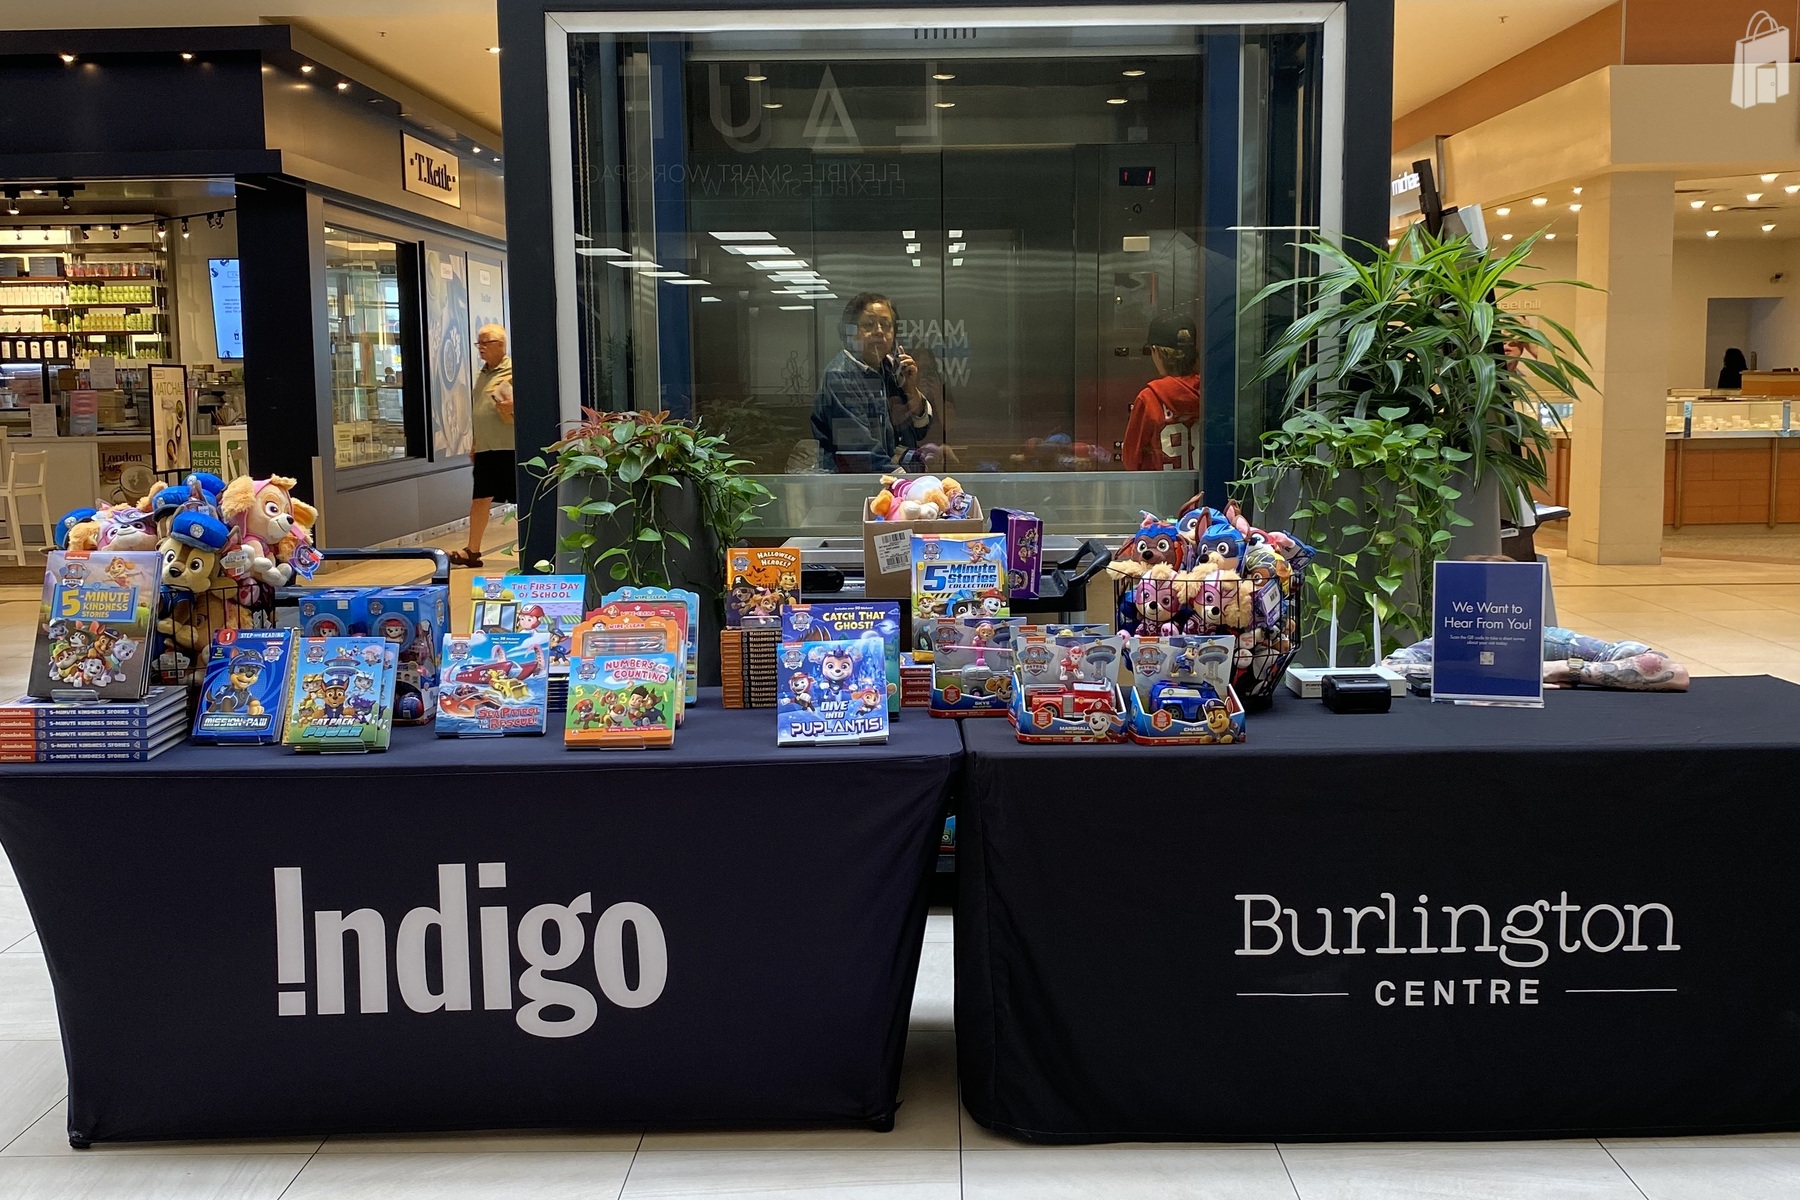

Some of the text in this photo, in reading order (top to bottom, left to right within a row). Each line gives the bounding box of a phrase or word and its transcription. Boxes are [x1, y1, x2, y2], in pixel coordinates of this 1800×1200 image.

[1391, 172, 1421, 197] michae
[102, 452, 143, 463] London
[756, 551, 797, 562] HALLOWEEN
[761, 559, 792, 568] HEROES!
[947, 574, 997, 584] Stories
[529, 582, 557, 590] FIRST
[560, 582, 580, 590] DAY
[531, 591, 571, 599] SCHOOL
[83, 602, 129, 612] KINDNESS
[1452, 601, 1523, 614] We Want to
[81, 611, 110, 619] STORIES
[822, 611, 886, 622] CATCH THAT
[834, 621, 874, 631] GHOST!
[1444, 616, 1532, 630] Hear From You!
[605, 658, 655, 670] NUMBERS
[613, 670, 667, 683] COUNTING
[500, 706, 541, 718] PATROL
[820, 700, 849, 712] DIVE
[311, 717, 356, 726] CAT PACK
[489, 717, 539, 730] RESCUE!
[790, 717, 883, 738] PUPLANTIS!
[302, 726, 364, 738] POWER
[1234, 891, 1682, 968] Burlington
[1373, 978, 1541, 1007] CENTRE
